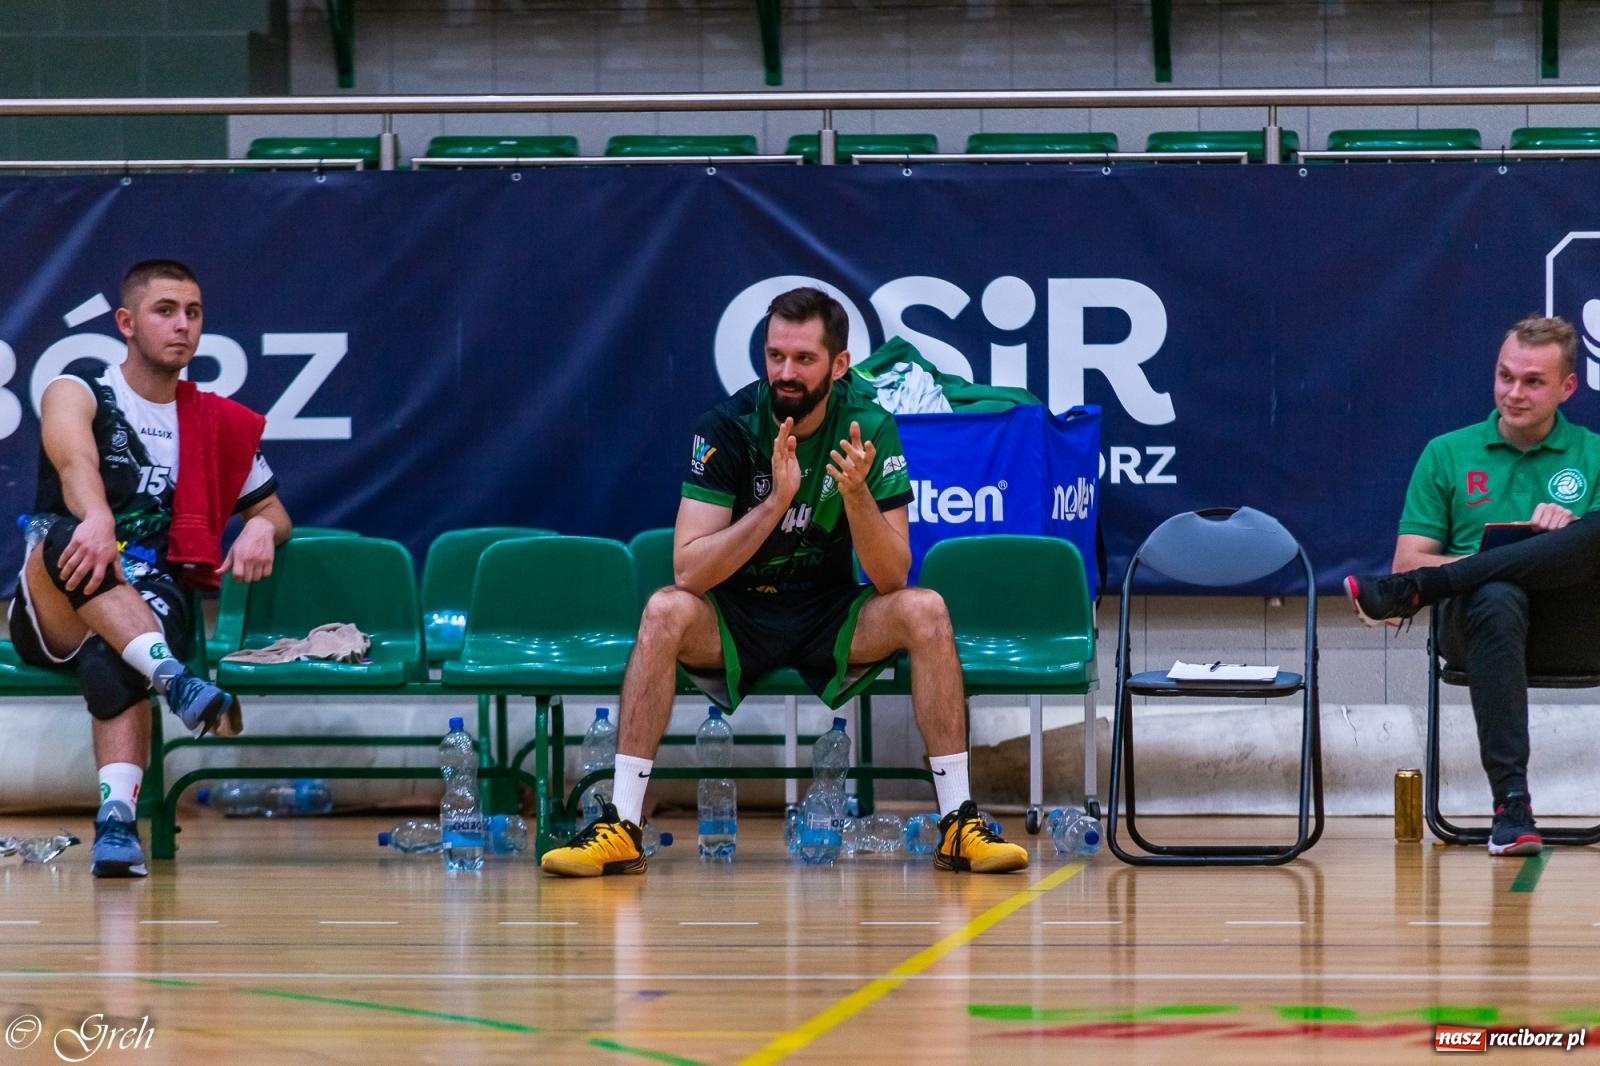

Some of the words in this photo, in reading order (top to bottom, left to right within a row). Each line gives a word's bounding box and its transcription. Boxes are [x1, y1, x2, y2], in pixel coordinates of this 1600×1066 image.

[713, 275, 1176, 425] OSiR
[141, 428, 173, 440] ALLSIX
[136, 465, 171, 496] 15
[1098, 446, 1178, 485] RZ
[1467, 470, 1489, 494] R
[781, 503, 812, 534] 44
